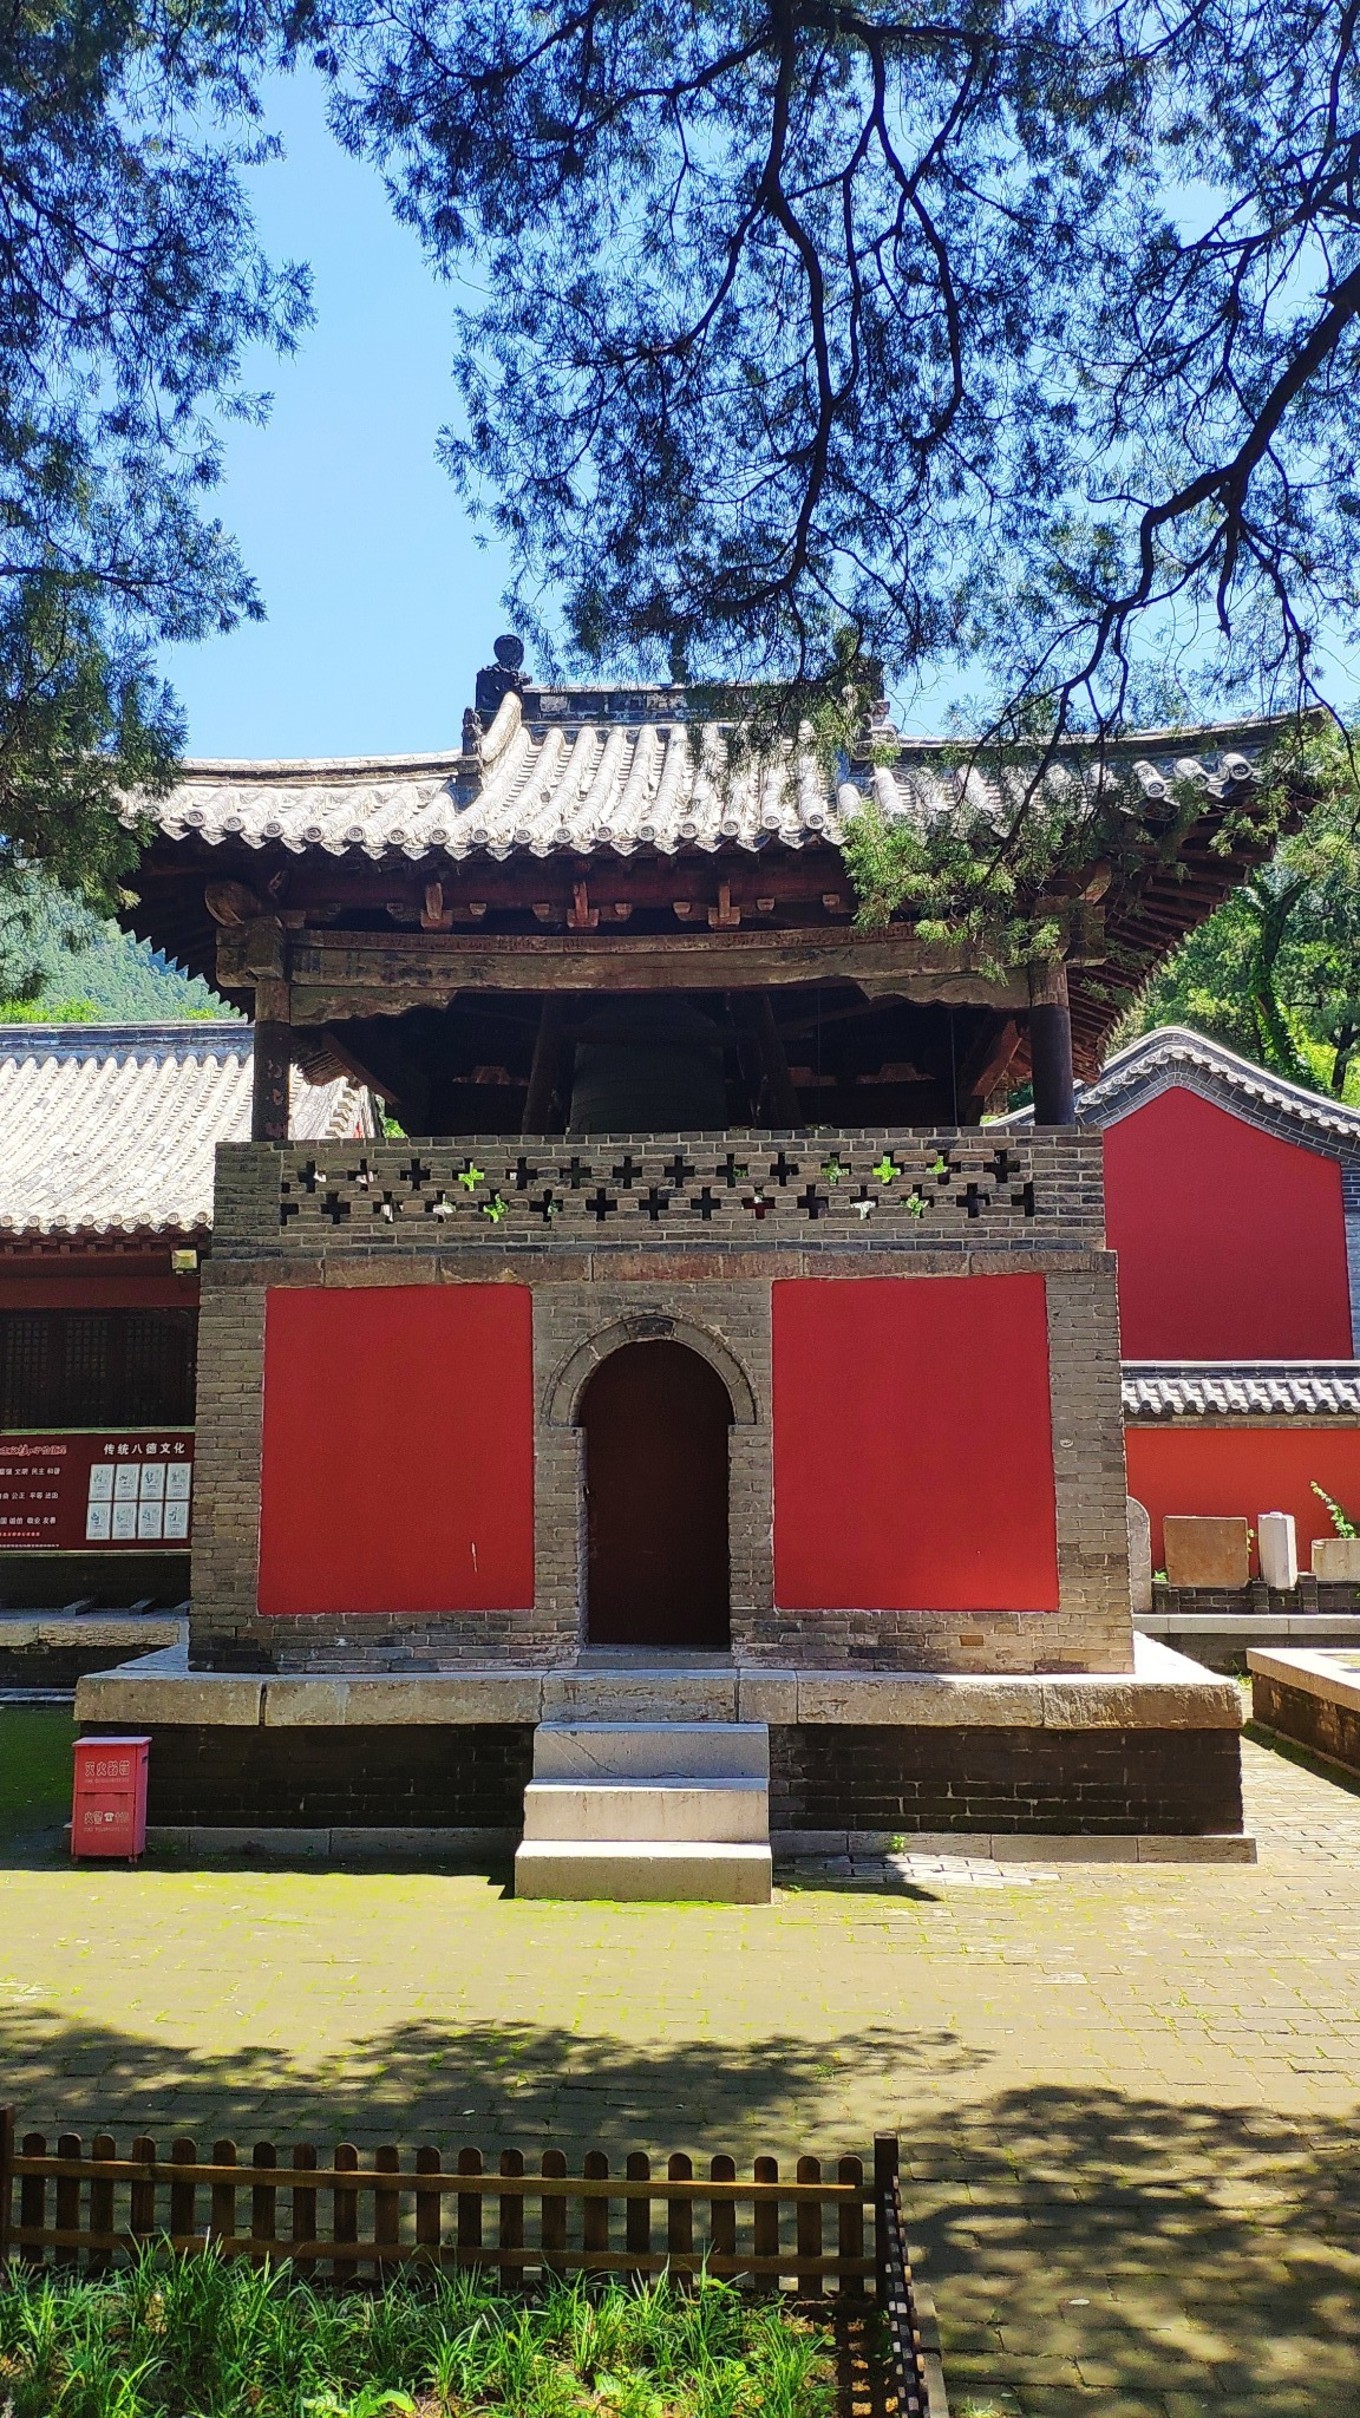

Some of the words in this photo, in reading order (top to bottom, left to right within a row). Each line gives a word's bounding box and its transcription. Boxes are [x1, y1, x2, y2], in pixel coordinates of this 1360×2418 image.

[104, 1442, 185, 1455] 传统八德文化
[85, 1760, 130, 1777] 灭火器箱
[84, 1811, 103, 1825] 火警
